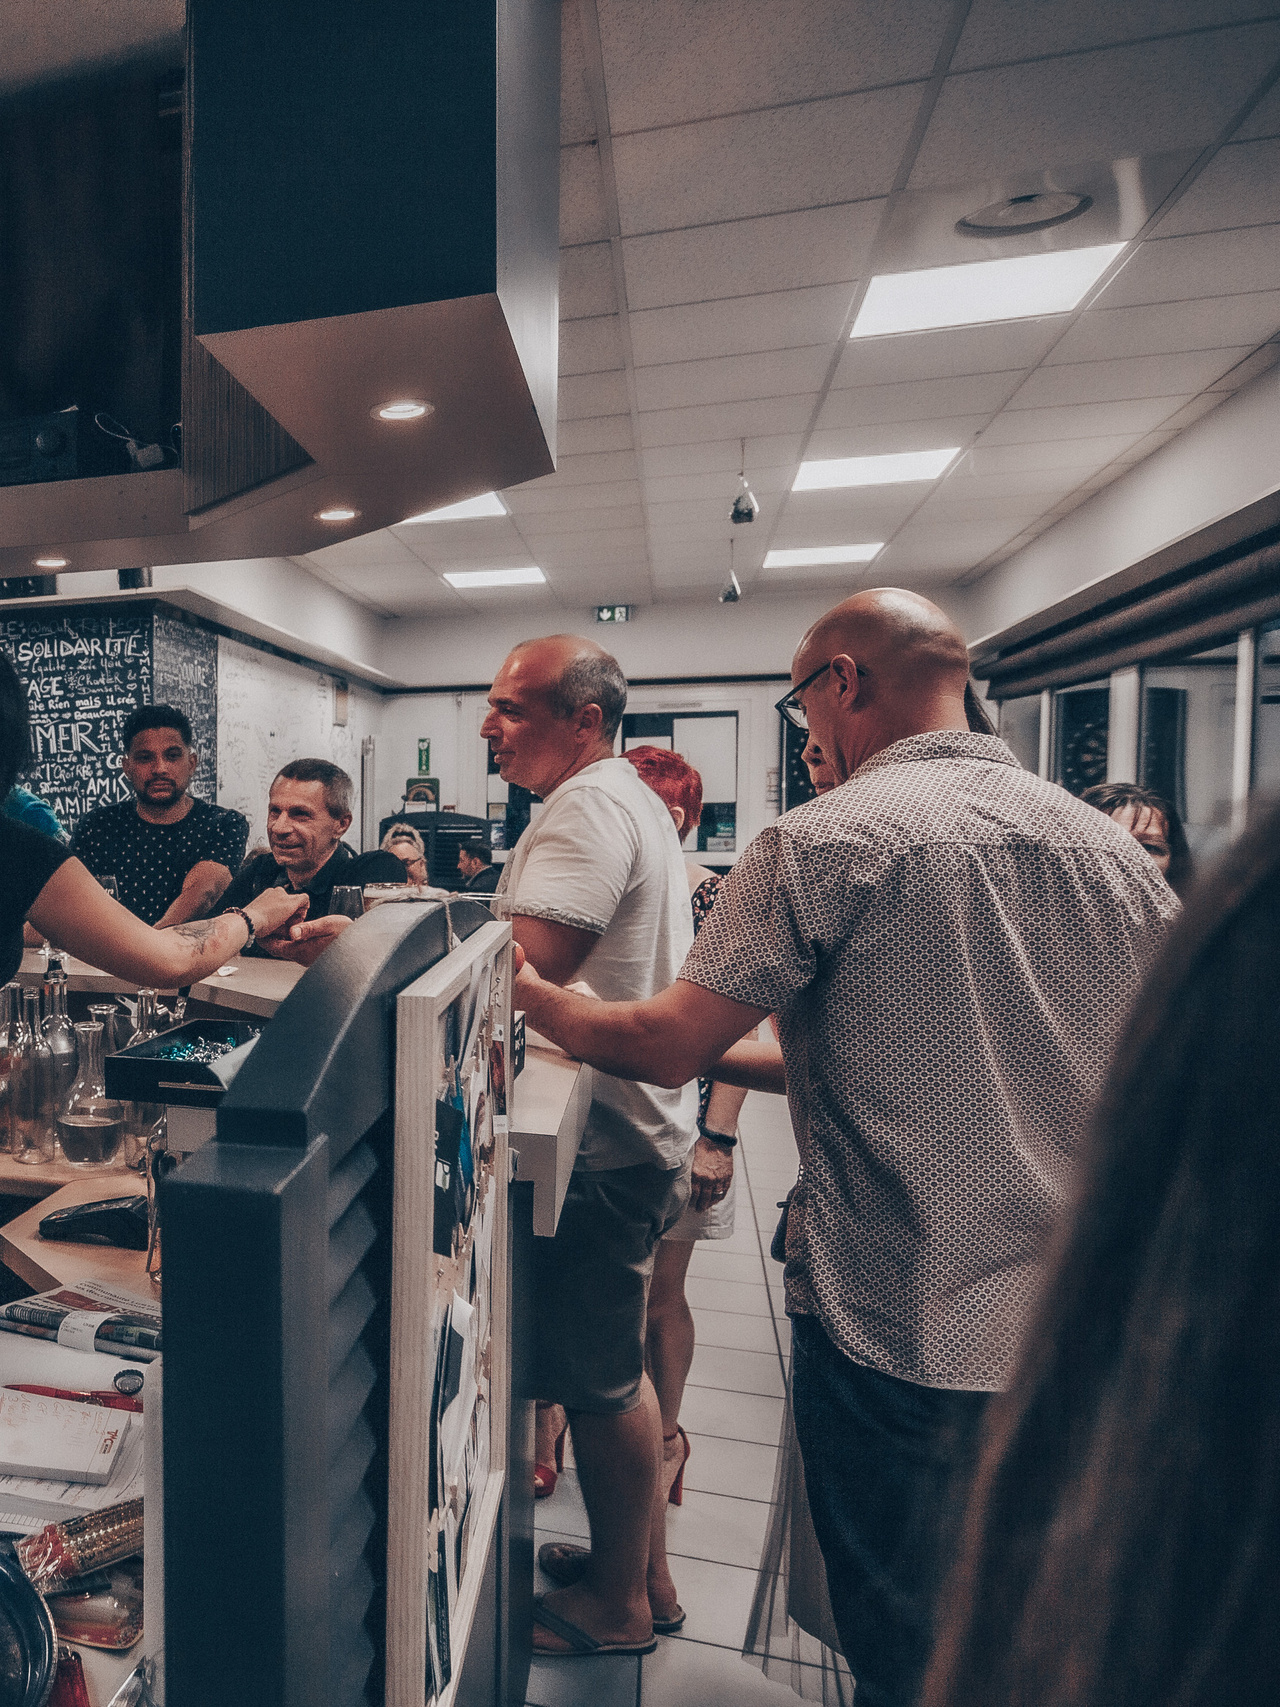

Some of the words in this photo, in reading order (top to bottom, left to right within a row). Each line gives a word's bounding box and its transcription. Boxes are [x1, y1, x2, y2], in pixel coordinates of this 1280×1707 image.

[18, 629, 143, 661] SOLIDARITÉ
[27, 677, 64, 699] AGE
[48, 697, 70, 710] Rien
[75, 697, 101, 709] mais
